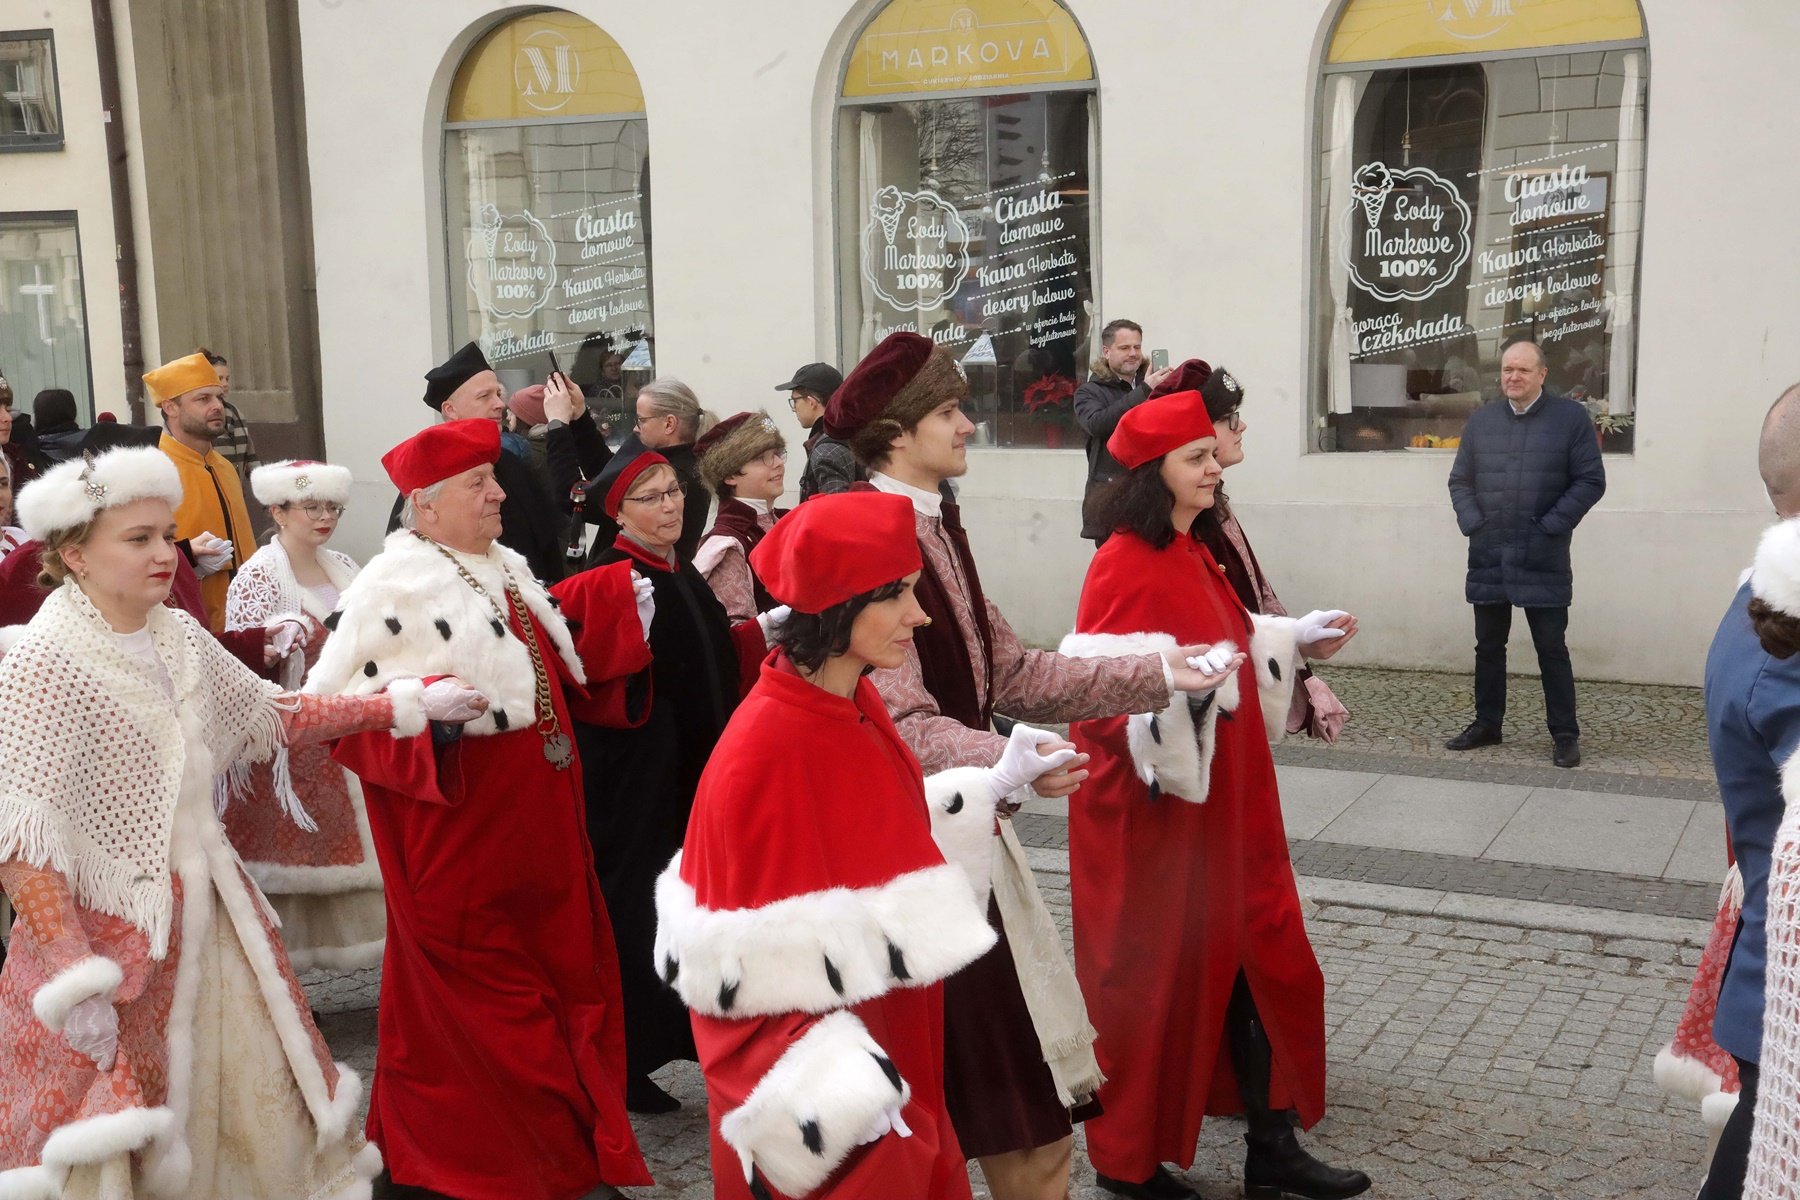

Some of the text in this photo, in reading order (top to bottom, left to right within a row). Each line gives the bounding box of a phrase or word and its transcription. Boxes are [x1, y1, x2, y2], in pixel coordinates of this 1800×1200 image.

[882, 37, 1050, 71] MARKOVA
[1504, 163, 1591, 203] Ciasta
[994, 190, 1063, 224] Ciasta
[1393, 195, 1445, 232] Lody
[1508, 194, 1591, 227] domowe
[575, 209, 638, 242] Ciasta
[906, 216, 947, 249] Lody
[1000, 216, 1065, 245] domowe
[504, 232, 538, 262] Lody
[581, 234, 635, 260] domowe
[884, 244, 957, 270] Markove
[1364, 228, 1454, 257] Markove
[1477, 230, 1605, 274] Kawa Herbata
[486, 258, 546, 281] Markove
[562, 265, 645, 298] Kawa Herbata
[896, 273, 944, 290] 100%
[976, 249, 1077, 288] Kawa Herbata
[1379, 259, 1438, 278] 100%
[496, 285, 536, 299] 100%
[982, 286, 1076, 317] desery lodowe
[1484, 271, 1602, 307] desery lodowe
[568, 299, 645, 324] desery lodowe
[1034, 318, 1059, 333] ofercie
[1060, 311, 1076, 325] lody
[1548, 303, 1579, 323] ofercie
[1581, 297, 1602, 313] lody
[1350, 312, 1404, 344] gorąca
[1361, 313, 1464, 352] czekolada
[1542, 318, 1602, 342] bezglutenowe
[488, 330, 557, 360] czekolada
